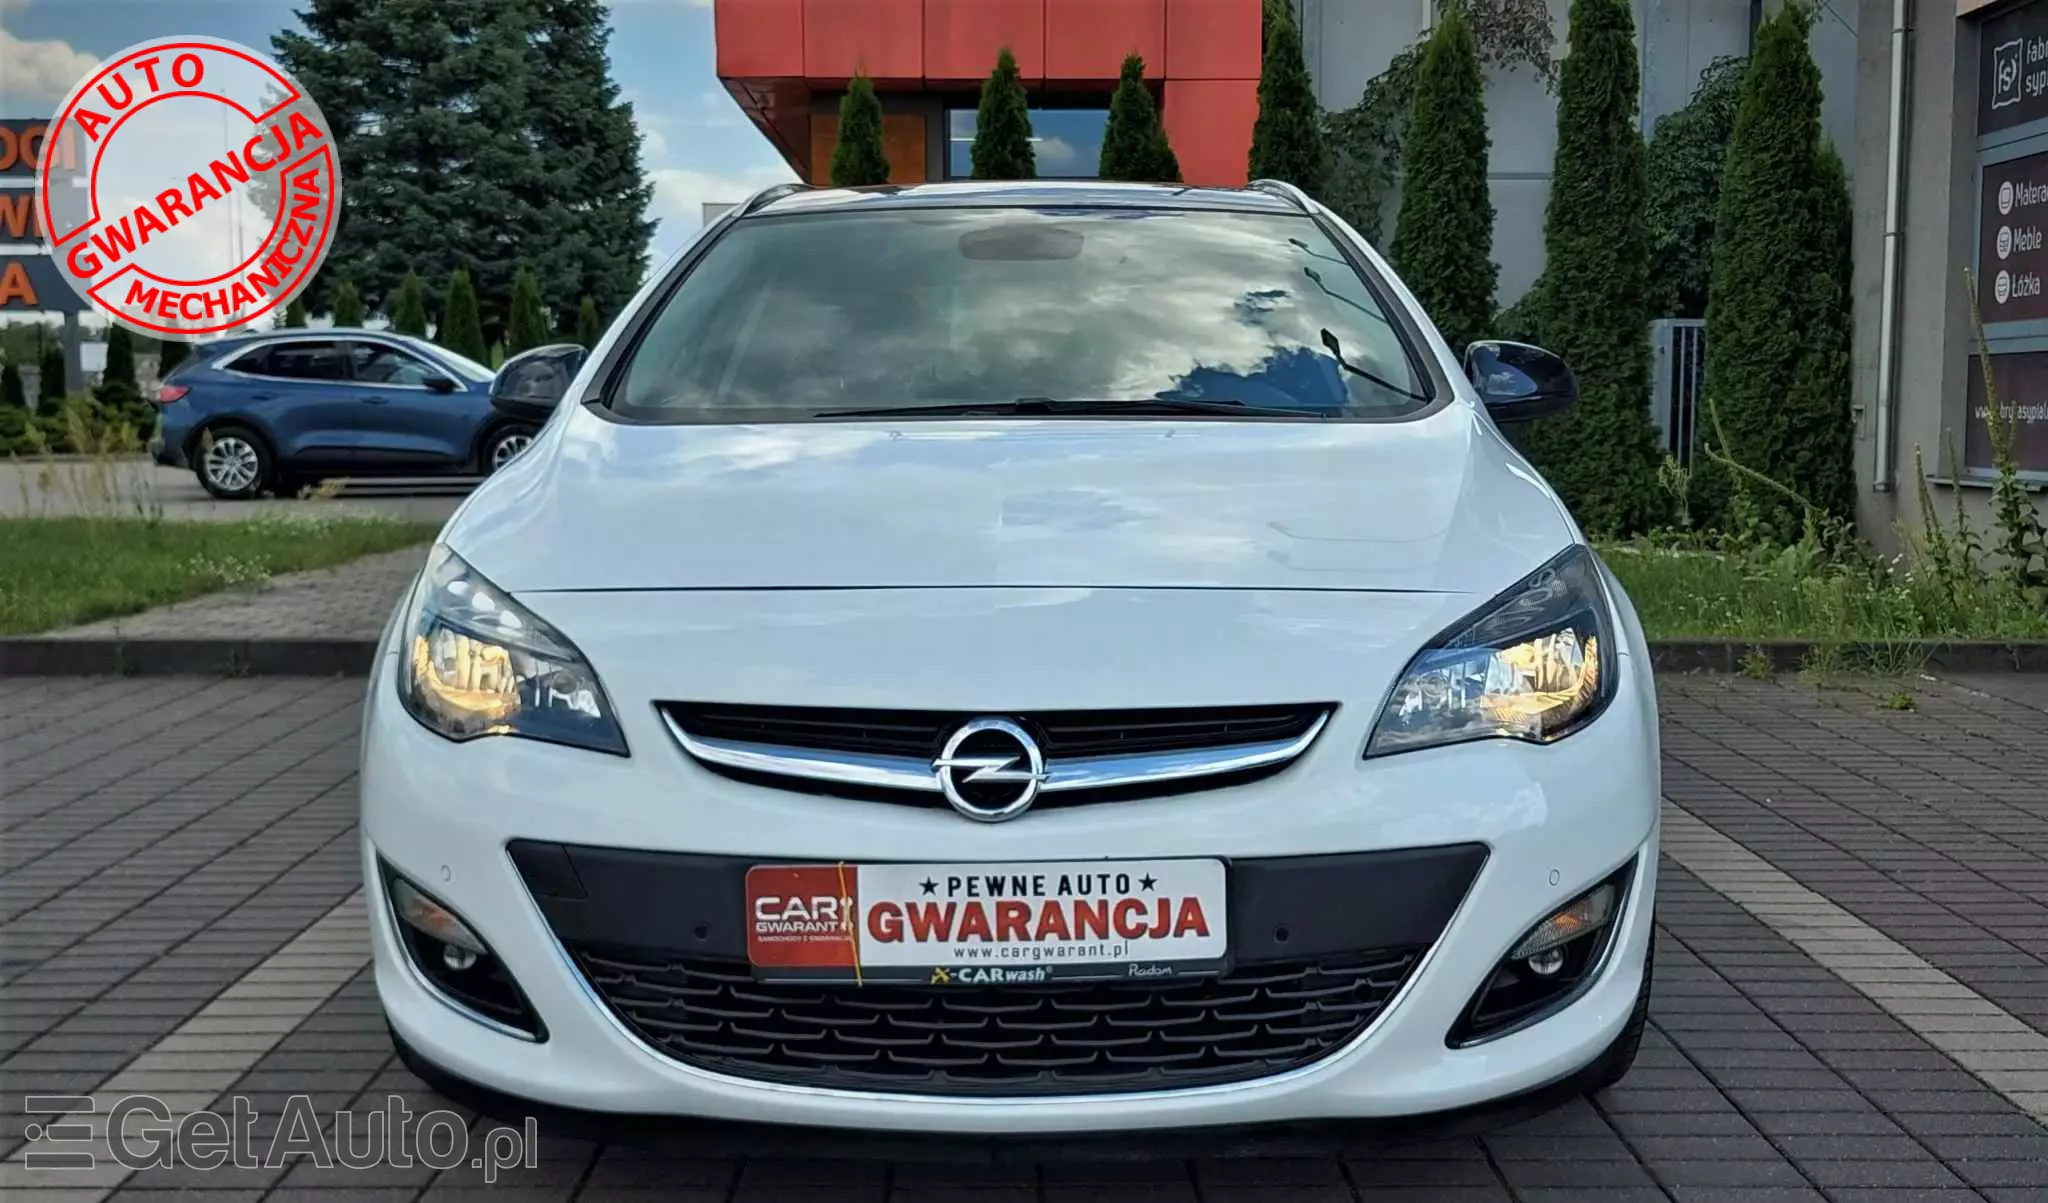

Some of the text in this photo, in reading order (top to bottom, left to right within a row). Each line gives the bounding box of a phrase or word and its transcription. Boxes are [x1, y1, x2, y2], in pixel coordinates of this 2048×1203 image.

[2025, 70, 2048, 97] syp
[2012, 225, 2043, 254] Meble
[2011, 271, 2041, 298] Łóżka
[947, 873, 1130, 898] PEWNE AUTO
[755, 896, 839, 921] CAR
[867, 896, 1211, 944] GWARANCJA
[755, 921, 839, 933] GWARANT
[953, 939, 1129, 961] www.cargwarant.pl
[1127, 963, 1173, 978] Radom
